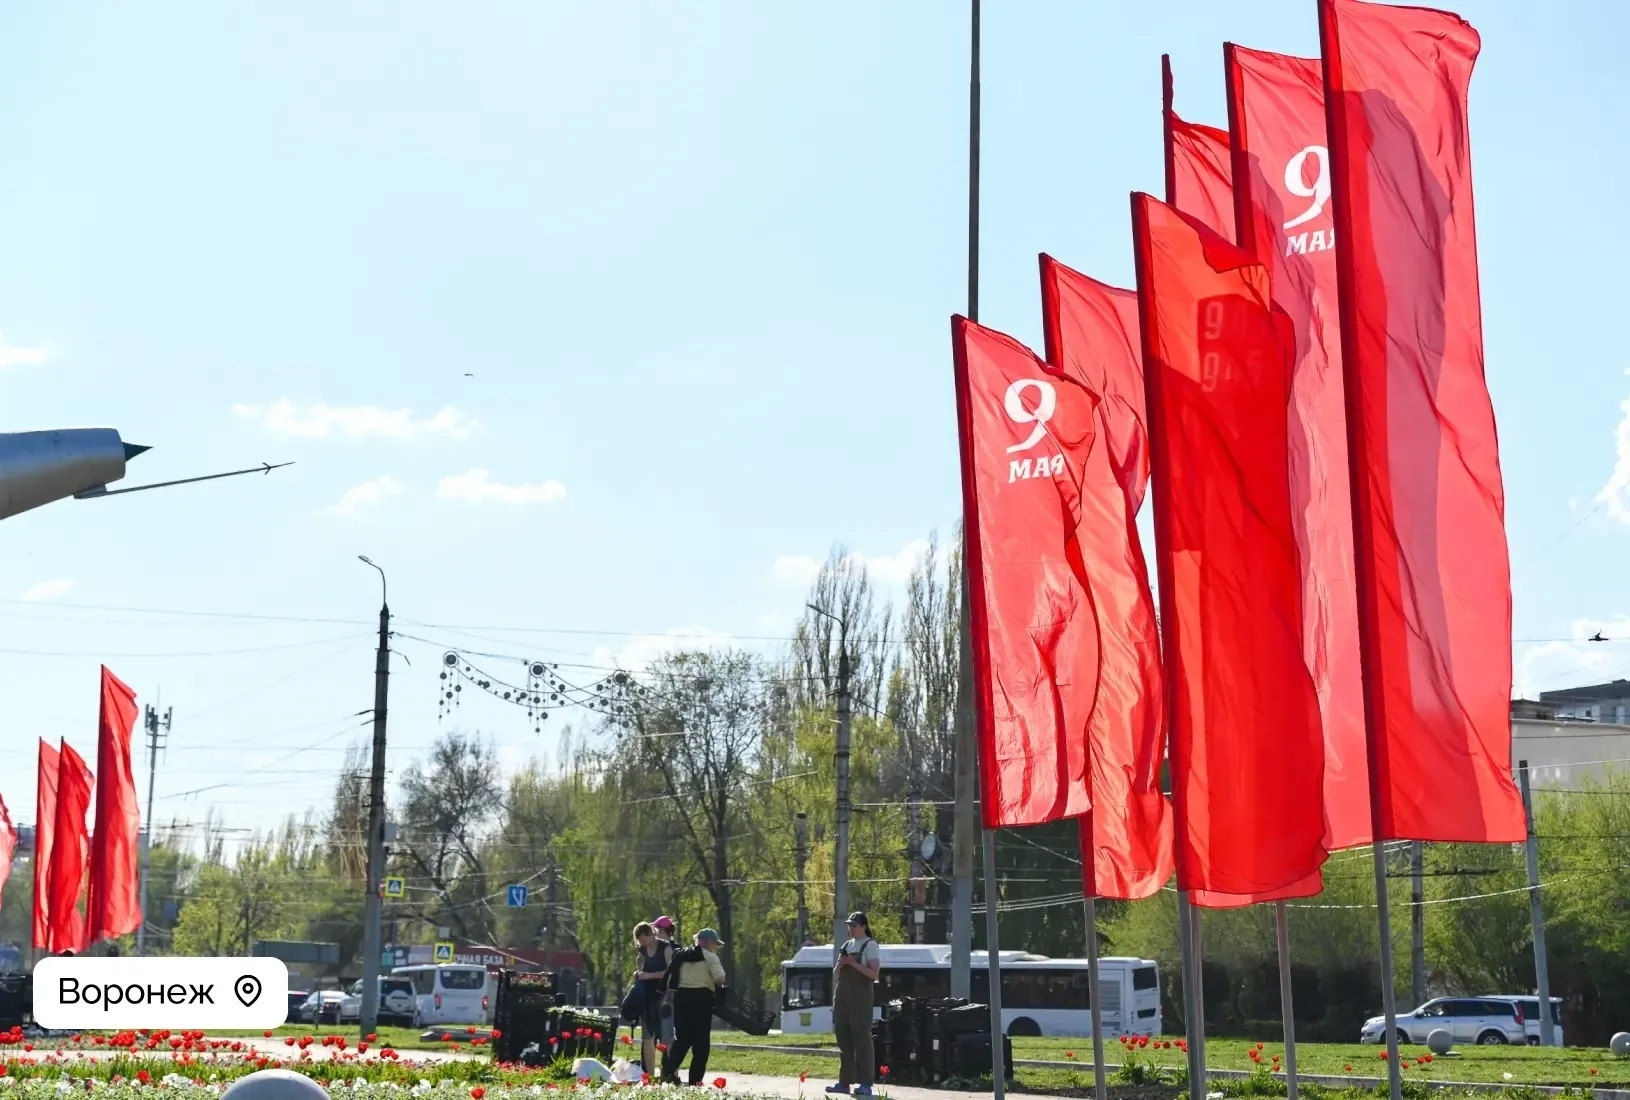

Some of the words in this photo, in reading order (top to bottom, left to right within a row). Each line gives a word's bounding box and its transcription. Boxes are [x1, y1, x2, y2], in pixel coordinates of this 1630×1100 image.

[1282, 145, 1331, 229] 9
[1004, 378, 1056, 454] 9
[1008, 453, 1065, 483] МАЯ
